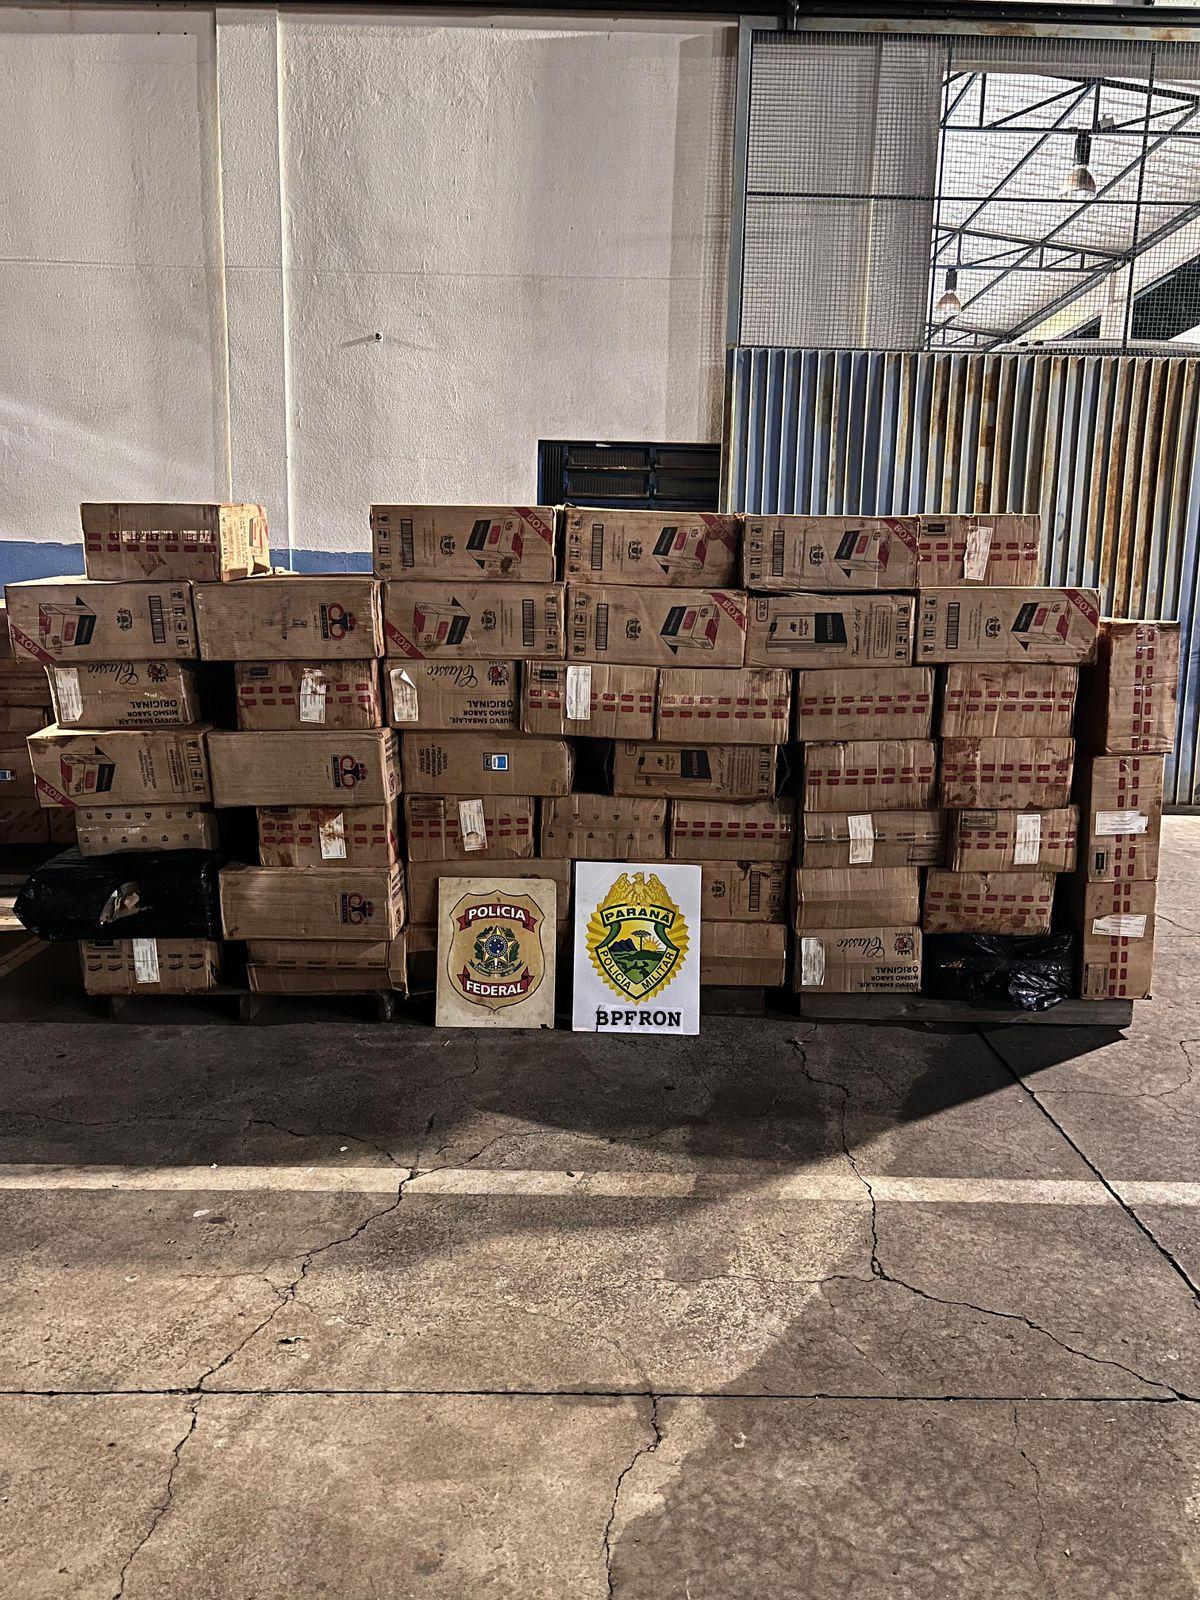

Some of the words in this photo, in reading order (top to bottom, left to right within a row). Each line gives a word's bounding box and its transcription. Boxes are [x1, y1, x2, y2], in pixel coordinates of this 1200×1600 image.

[526, 514, 547, 535] BOX
[894, 523, 913, 544] BOX
[722, 600, 741, 620] BOX
[1074, 596, 1094, 616] BOX
[18, 635, 39, 656] BOX
[391, 630, 410, 651] BOX
[87, 662, 139, 685] Classic
[427, 664, 479, 688] Classic
[130, 700, 177, 709] ORIGINAL
[467, 700, 513, 708] ORIGINAL
[468, 905, 526, 921] POLÍCIA
[604, 907, 671, 922] PARANÁ
[836, 936, 885, 958] Classic
[641, 952, 675, 990] MILITAR
[875, 966, 919, 974] ORIGINAL
[466, 981, 524, 996] FEDERAL
[595, 1010, 682, 1027] BPFRON
